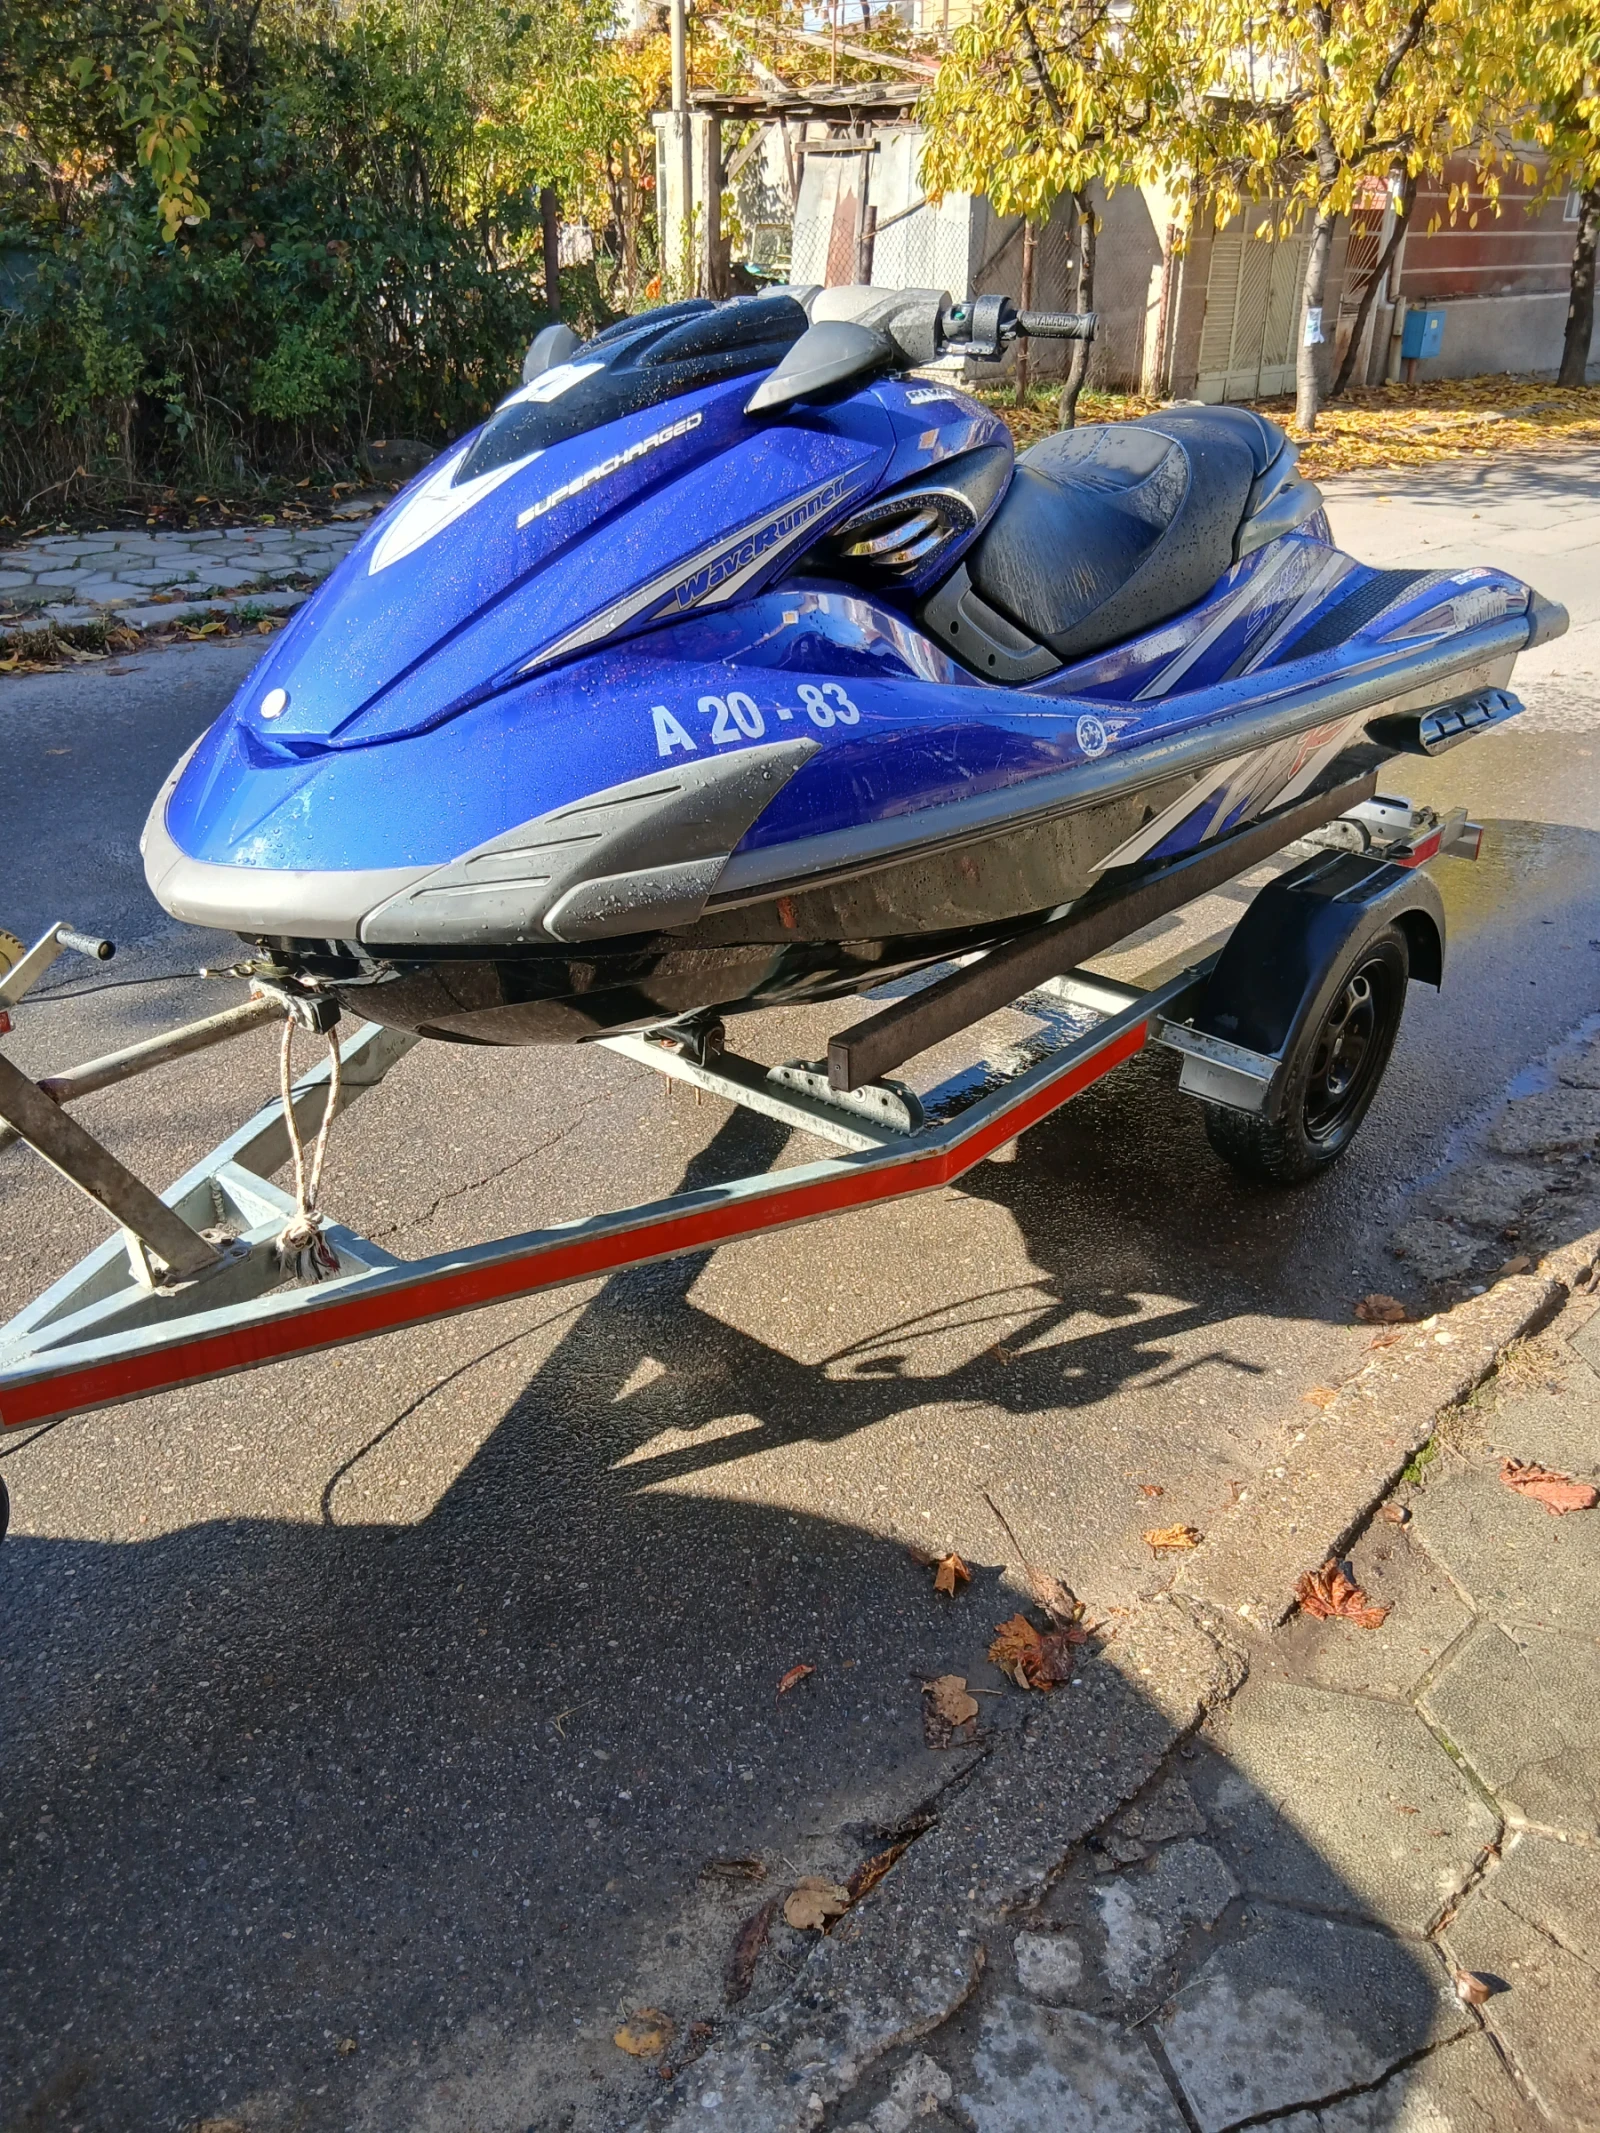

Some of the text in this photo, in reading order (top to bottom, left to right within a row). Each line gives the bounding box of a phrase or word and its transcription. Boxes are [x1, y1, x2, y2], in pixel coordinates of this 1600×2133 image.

[1036, 315, 1071, 327] YAMAHA
[907, 388, 951, 399] RIVA
[517, 412, 702, 529] SUPERCHARGED
[675, 475, 845, 610] WaveRunner
[651, 705, 697, 757] A
[698, 691, 765, 744] 20
[796, 682, 860, 728] 83
